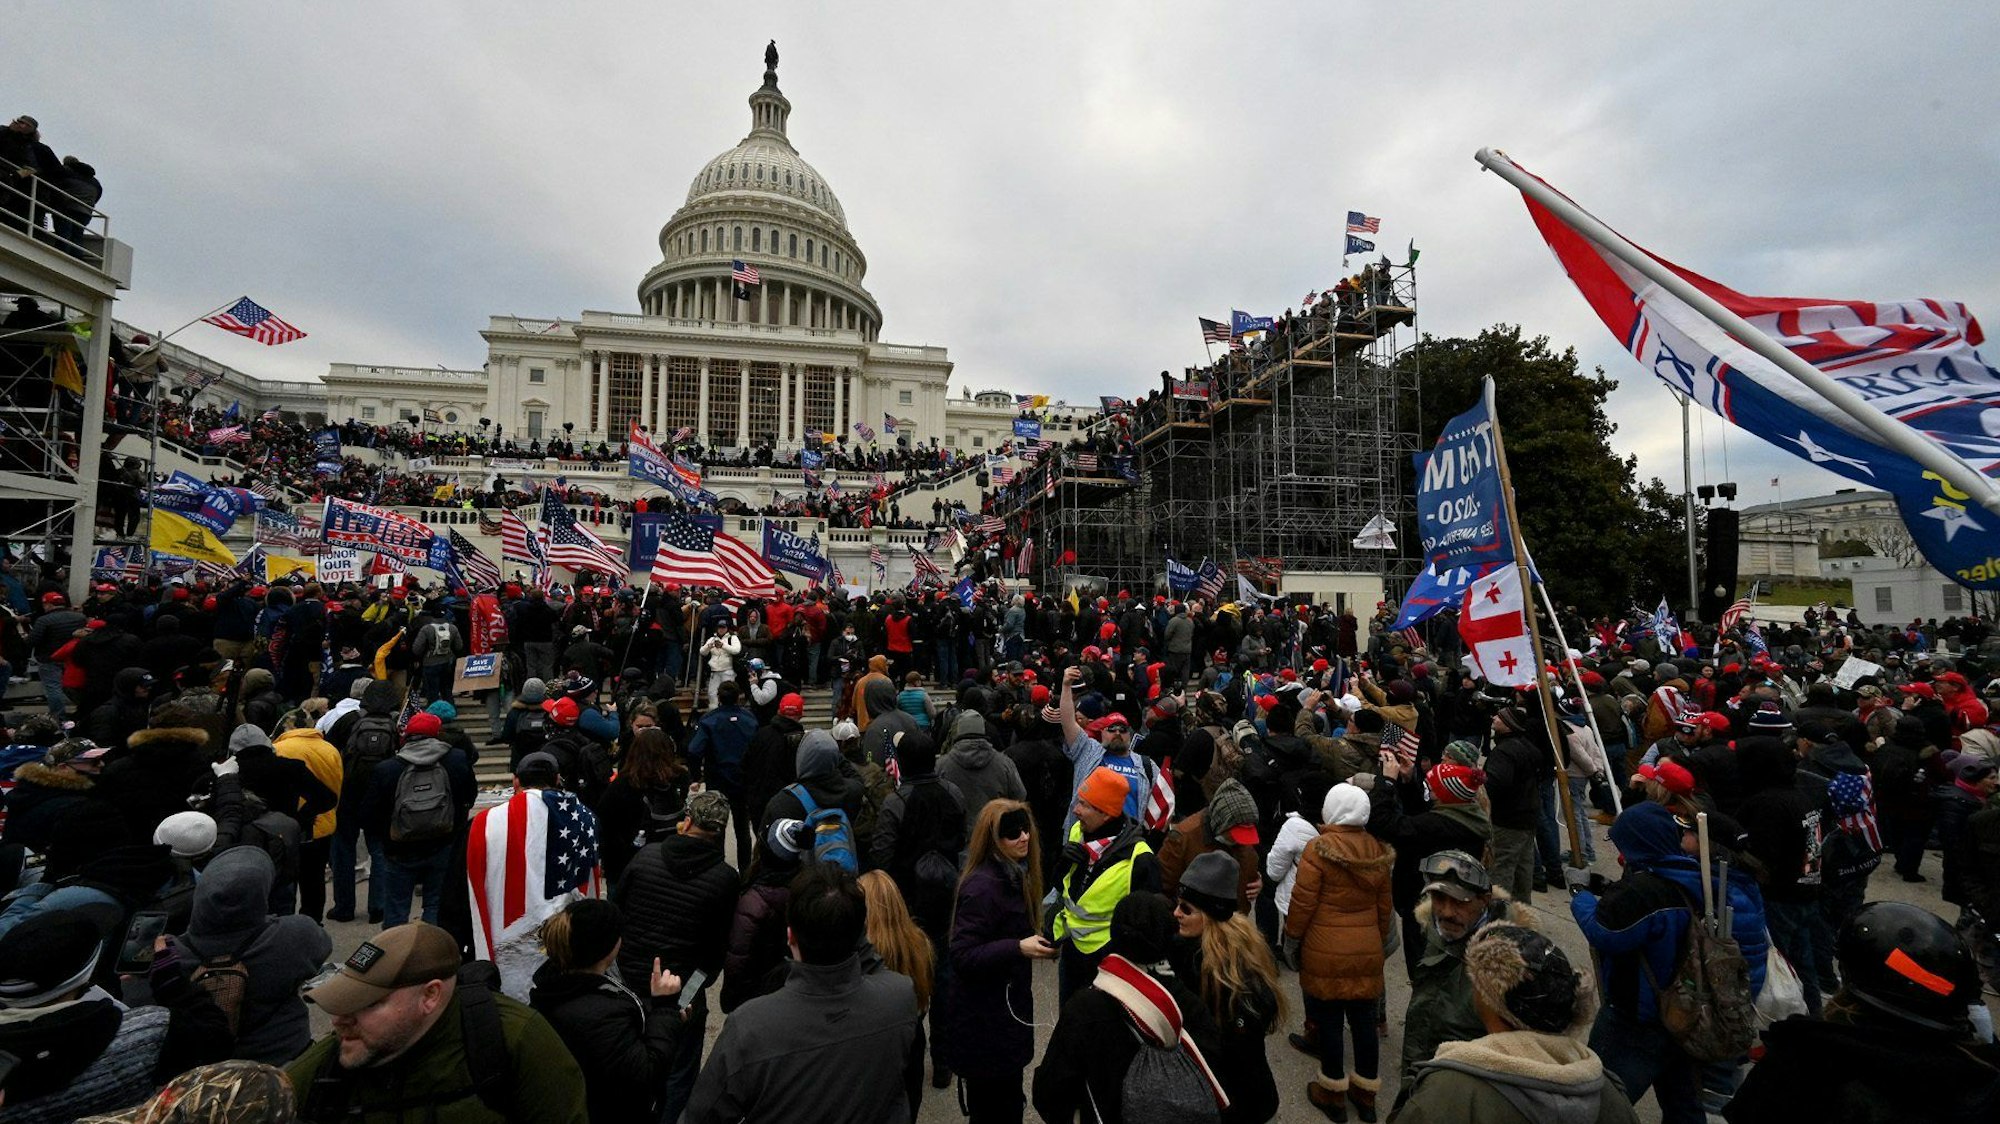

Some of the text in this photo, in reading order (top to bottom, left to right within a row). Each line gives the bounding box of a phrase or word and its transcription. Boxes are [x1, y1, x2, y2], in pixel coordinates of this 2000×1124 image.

[331, 504, 424, 547] TRUMP
[327, 537, 353, 548] KEEP
[771, 528, 822, 557] TRUMP
[396, 547, 428, 559] 020
[324, 560, 351, 570] OUR
[321, 570, 355, 581] VOTE
[489, 603, 505, 641] TRU
[466, 665, 491, 673] AMERICA
[1106, 763, 1137, 774] RUM
